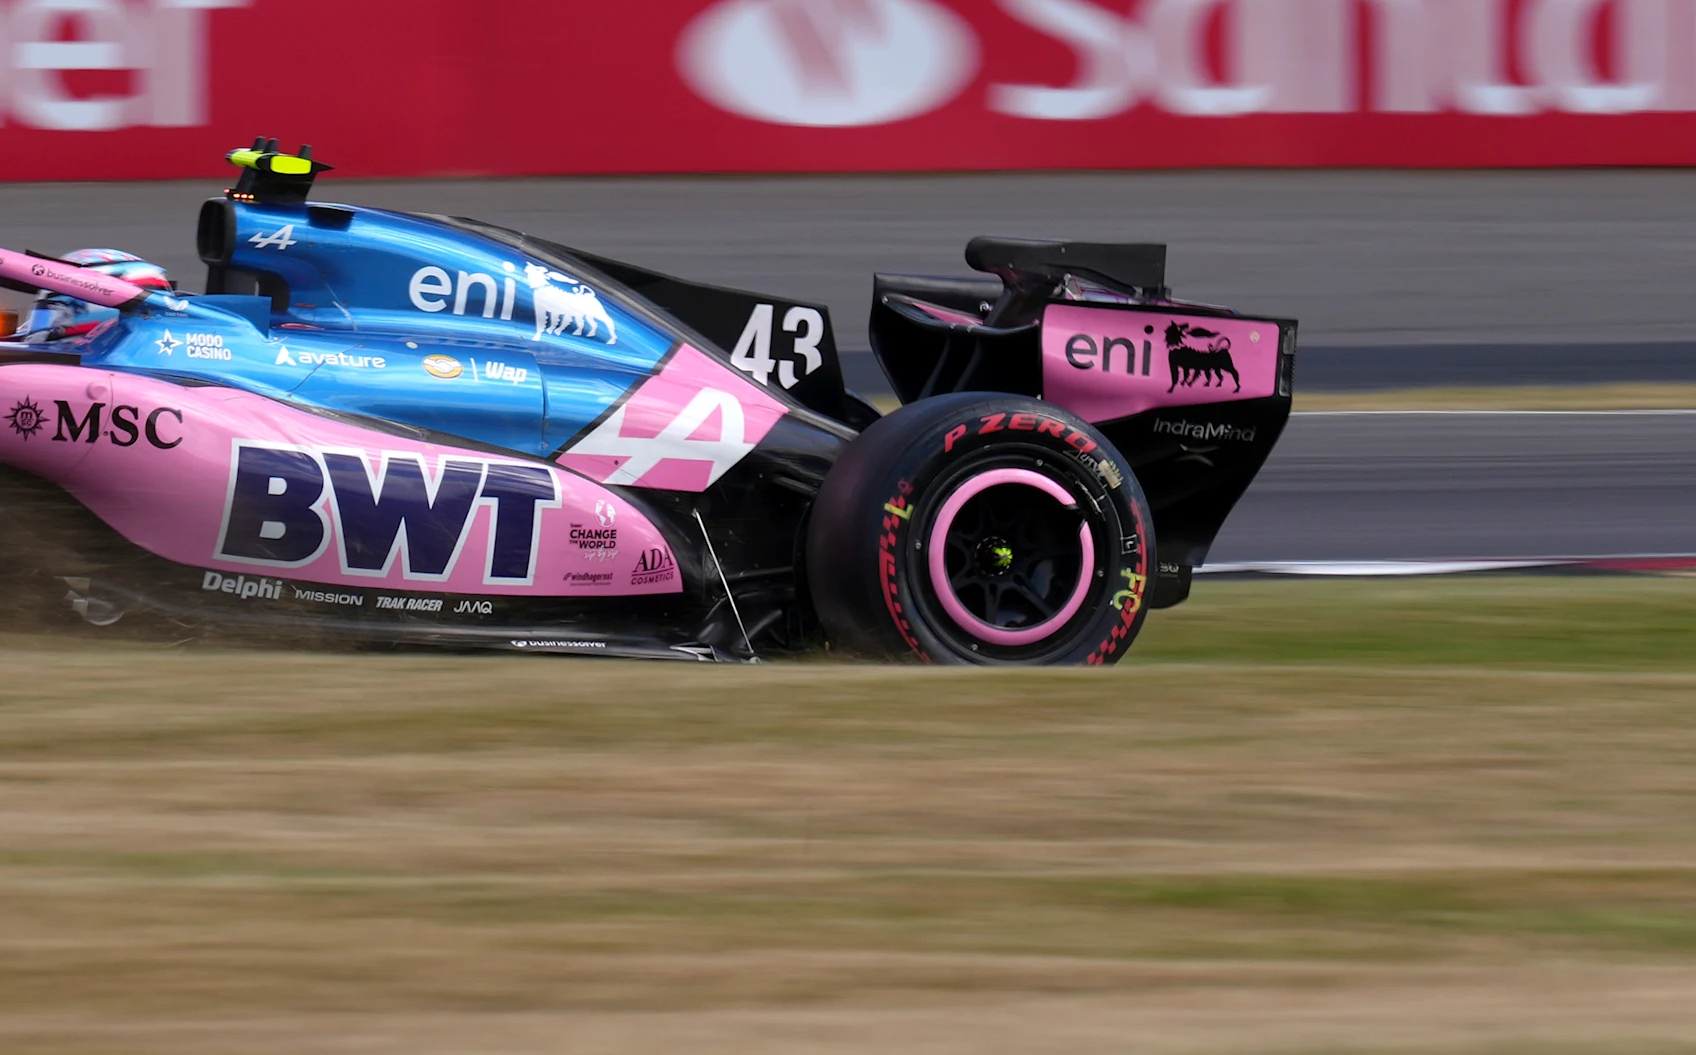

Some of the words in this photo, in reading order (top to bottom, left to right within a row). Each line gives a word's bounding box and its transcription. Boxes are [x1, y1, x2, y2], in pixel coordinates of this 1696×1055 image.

[47, 267, 115, 297] businessolver
[408, 262, 516, 321] eni
[185, 332, 223, 348] MODO
[187, 345, 232, 361] CASINO
[730, 303, 825, 390] 43
[1065, 324, 1155, 377] eni
[298, 351, 386, 369] avature
[485, 361, 527, 385] Wap
[52, 400, 184, 450] MSC
[944, 424, 967, 454] P
[977, 412, 1098, 454] ZERO
[1153, 417, 1256, 443] IndraMind
[213, 437, 563, 586] BWT
[569, 529, 617, 540] CHANGE
[579, 541, 617, 550] WORLD
[632, 545, 675, 573] ADA
[202, 571, 283, 600] Delphi
[295, 589, 363, 606] MISSION
[376, 596, 406, 609] TRAK
[406, 598, 443, 612] RACER
[630, 571, 674, 586] COSMETICS
